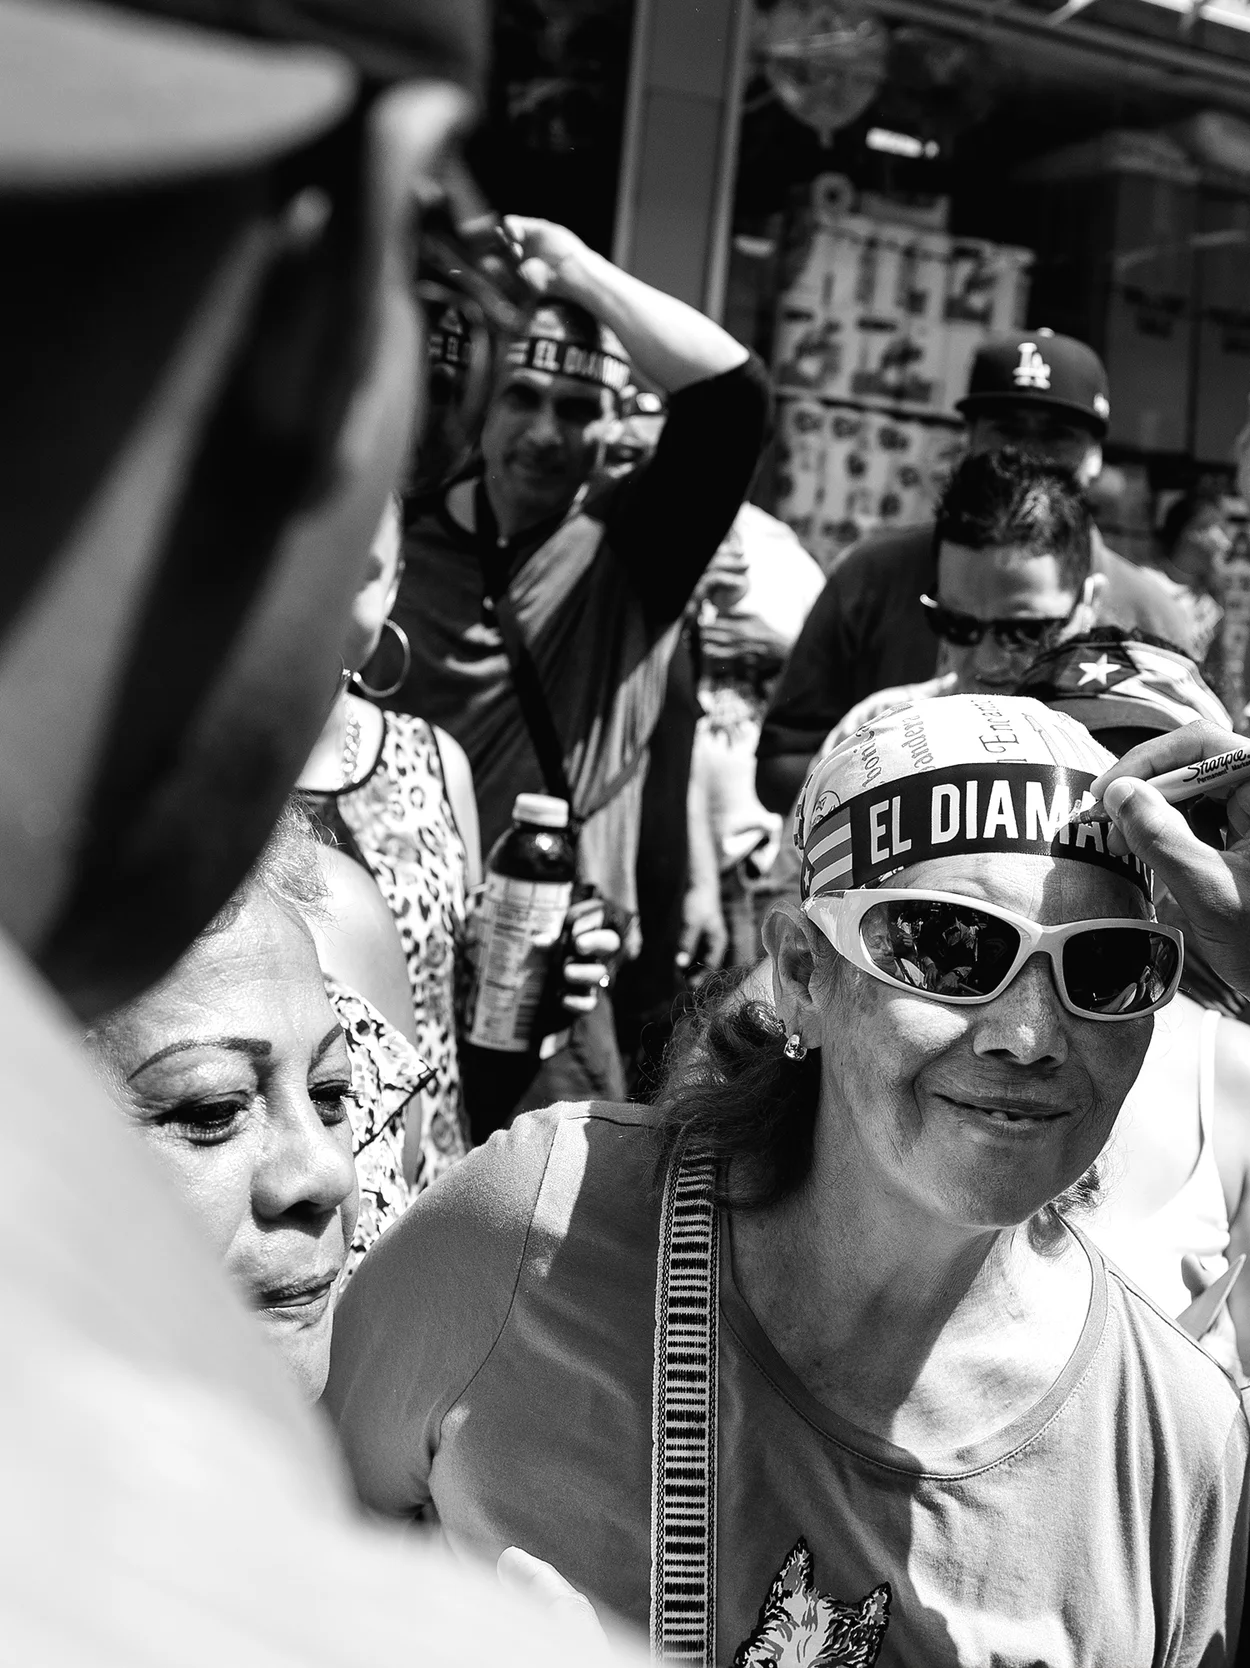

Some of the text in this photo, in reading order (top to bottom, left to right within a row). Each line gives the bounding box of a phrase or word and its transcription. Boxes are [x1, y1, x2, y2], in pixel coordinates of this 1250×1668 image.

[532, 339, 561, 372] EL
[1013, 342, 1050, 389] LA
[1183, 749, 1247, 782] Sharpie
[1197, 768, 1228, 784] Permanent
[869, 779, 1142, 875] EL DIAMA
